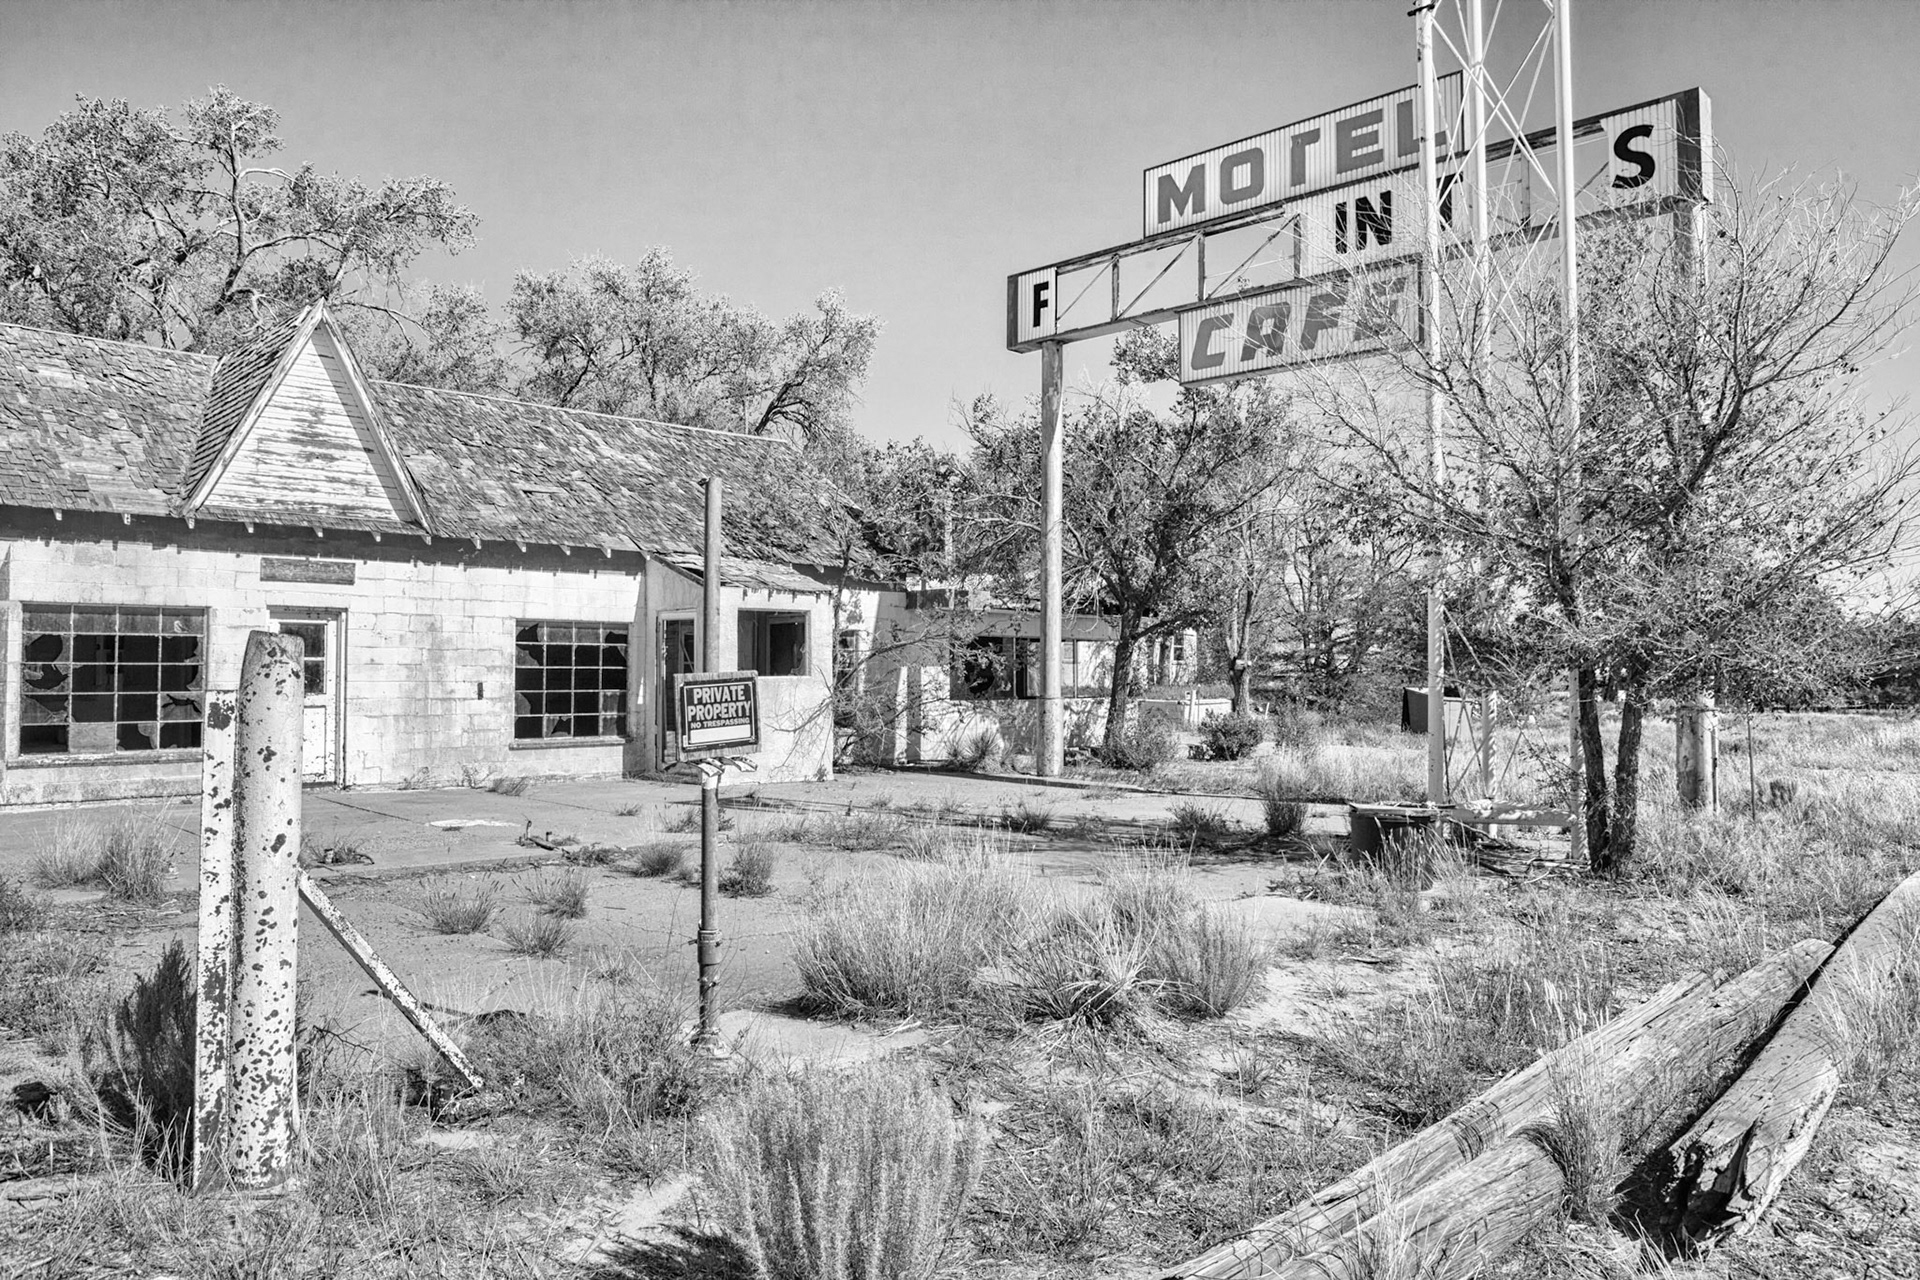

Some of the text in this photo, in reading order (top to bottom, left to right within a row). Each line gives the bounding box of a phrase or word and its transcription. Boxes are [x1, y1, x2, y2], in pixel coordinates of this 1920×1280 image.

[1157, 99, 1447, 225] MOTEL
[1033, 281, 1049, 328] F
[1334, 190, 1392, 255] IN
[1612, 124, 1656, 190] S
[1191, 277, 1407, 371] CAFE
[687, 701, 751, 722] PROPERTY
[690, 717, 750, 730] NO TRESPASSING
[693, 685, 745, 705] PRIVATE
